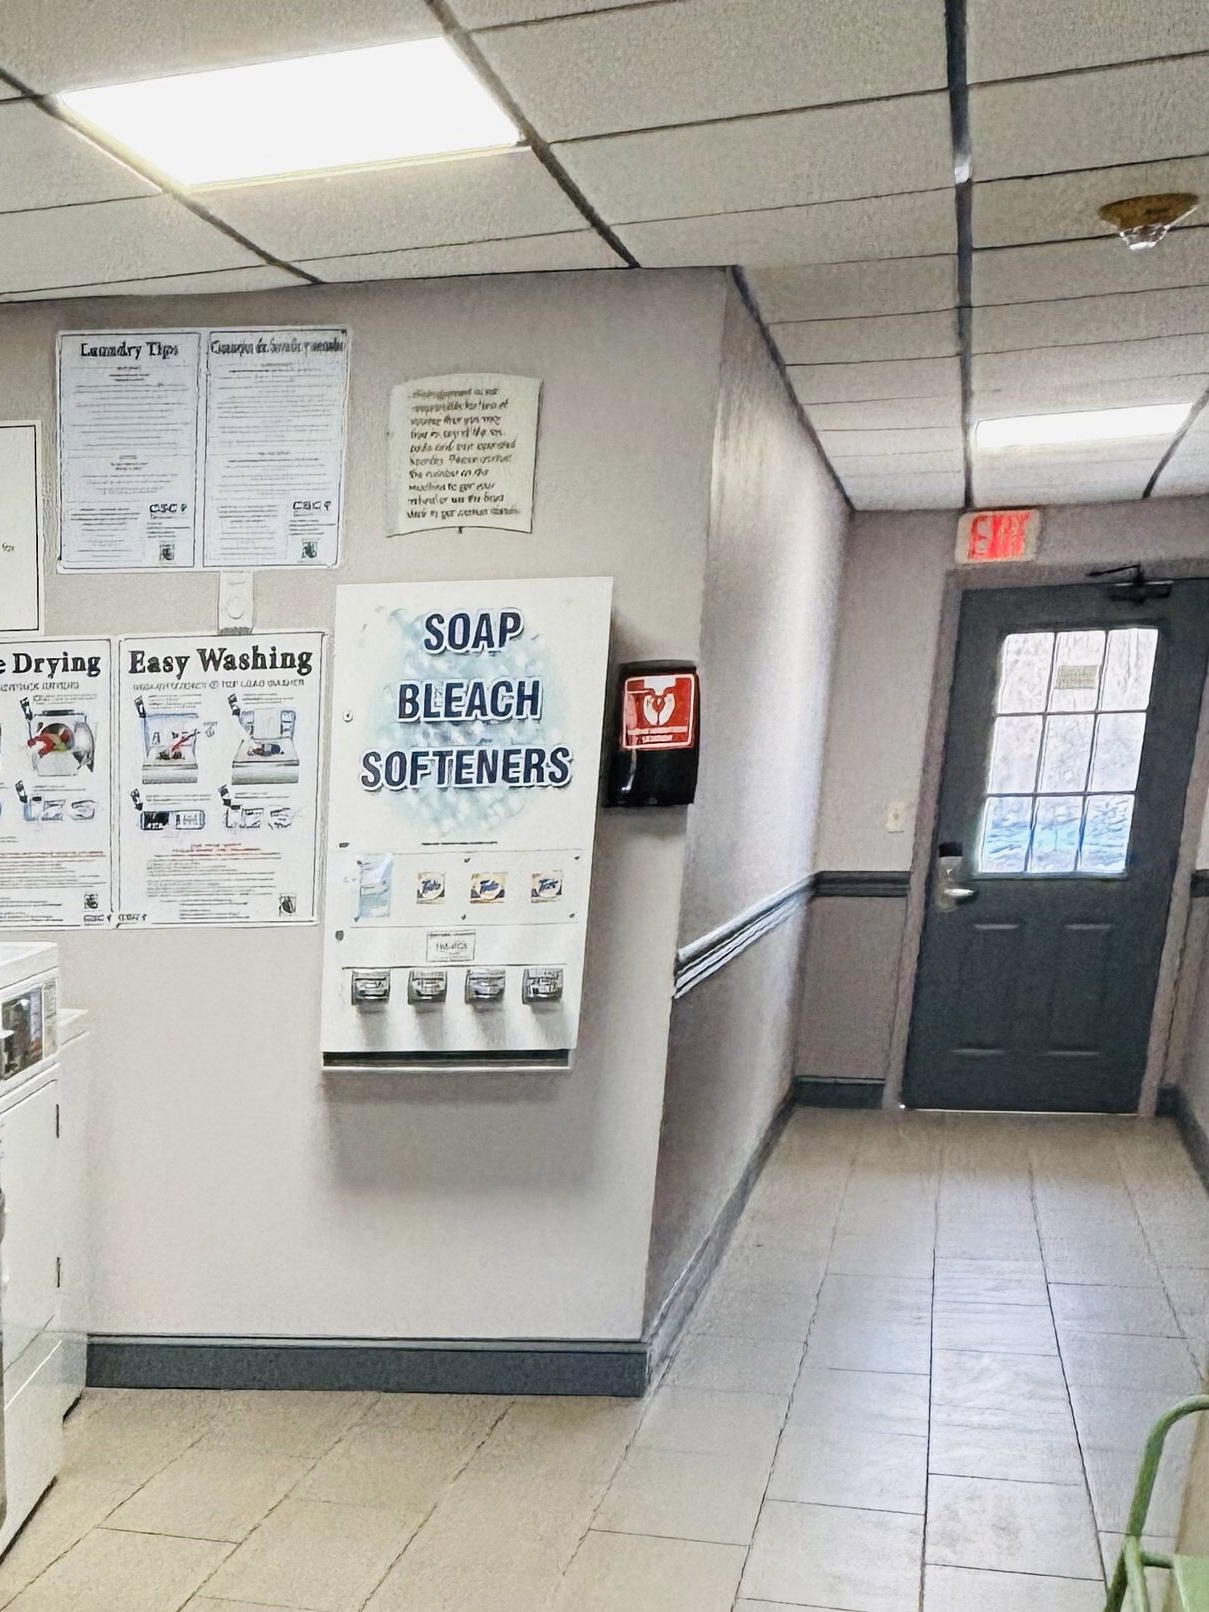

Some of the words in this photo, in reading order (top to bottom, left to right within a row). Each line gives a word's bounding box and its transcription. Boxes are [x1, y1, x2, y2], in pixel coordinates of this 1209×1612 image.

[80, 341, 142, 360] Laundry
[146, 341, 179, 359] Tips
[423, 611, 524, 650] SOAP
[12, 651, 101, 679] Drying
[128, 650, 191, 680] Easy
[196, 645, 313, 676] Washing
[398, 680, 541, 720] BLEACH
[361, 747, 573, 788] SOFTENERS
